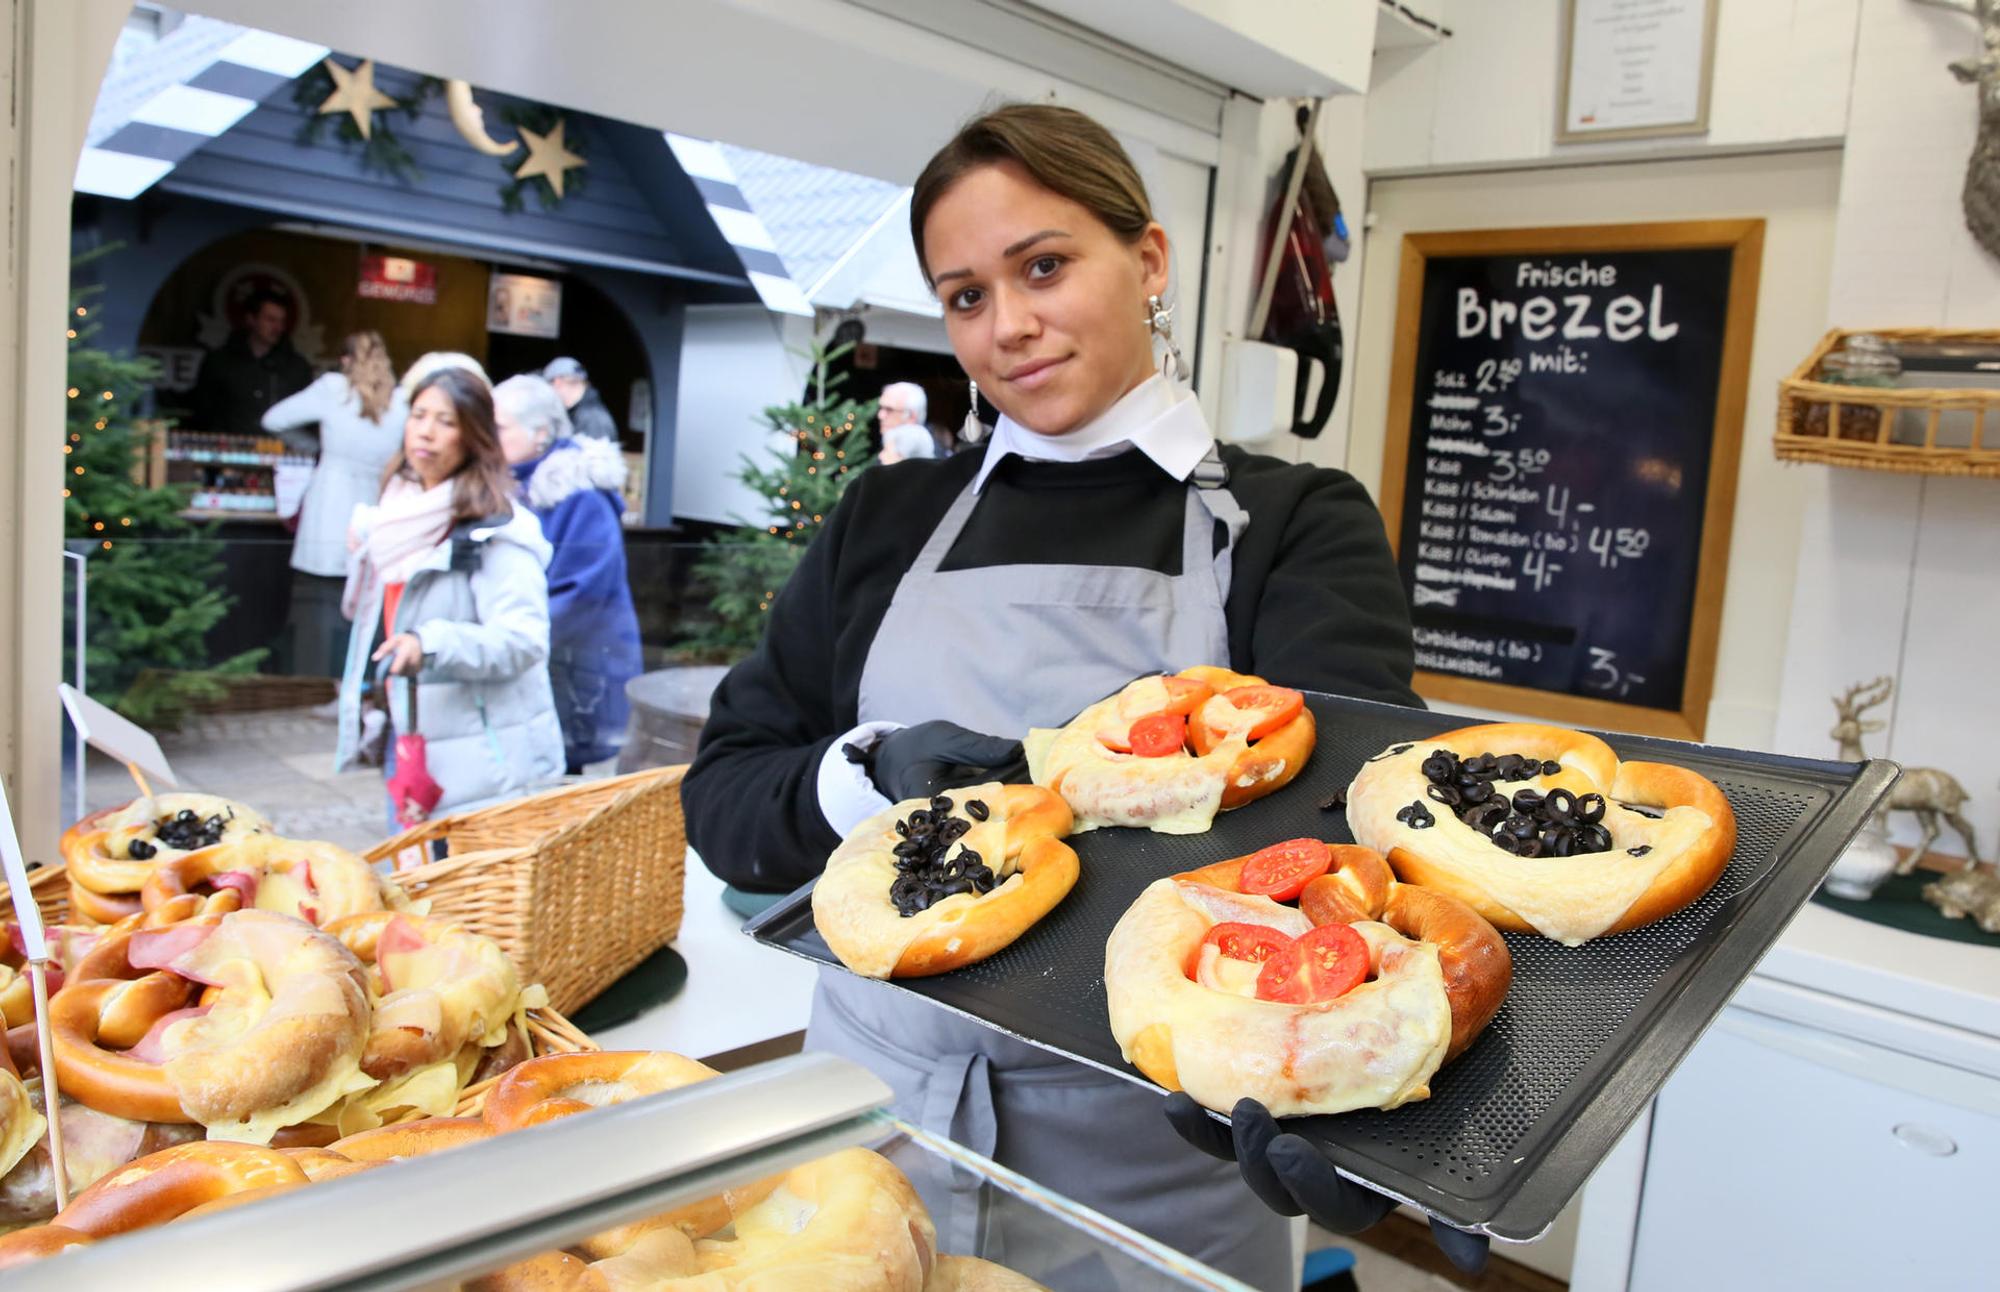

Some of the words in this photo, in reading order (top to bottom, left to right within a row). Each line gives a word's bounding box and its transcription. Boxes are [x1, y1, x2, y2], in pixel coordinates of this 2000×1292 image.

[1516, 259, 1617, 288] Frische
[1457, 284, 1679, 342] Brezel
[1530, 345, 1588, 373] mit:
